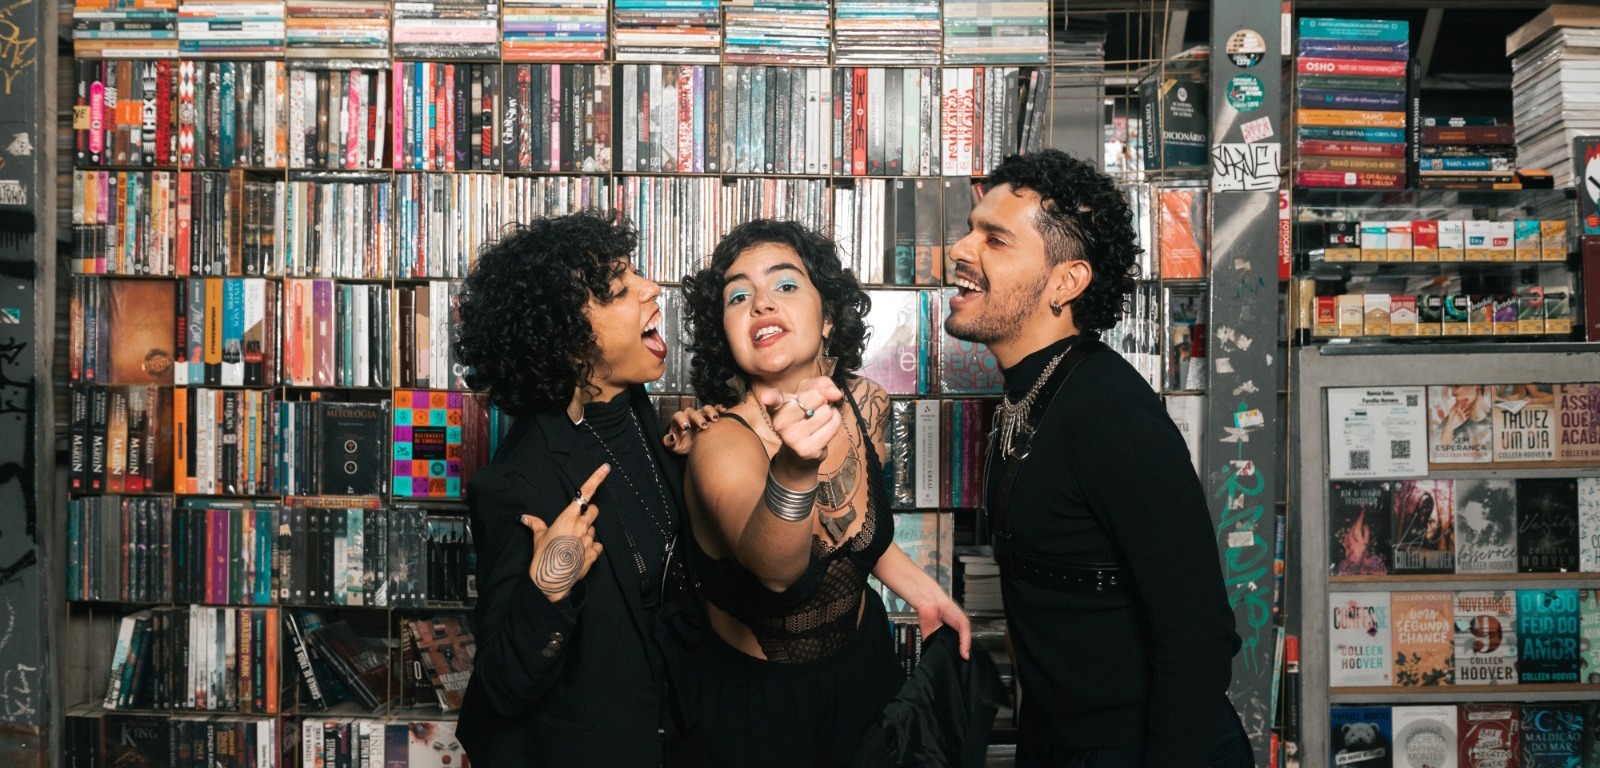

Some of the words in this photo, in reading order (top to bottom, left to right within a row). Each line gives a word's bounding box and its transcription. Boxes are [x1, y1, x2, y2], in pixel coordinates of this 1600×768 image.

[1306, 62, 1335, 72] OSHO
[143, 99, 157, 130] HEX
[1164, 131, 1205, 142] DICIONÁRIO
[327, 409, 377, 418] MITOLOGIA
[1502, 410, 1548, 429] TALVEZ
[1561, 412, 1589, 428] QUE
[1502, 431, 1522, 449] UM
[1528, 431, 1549, 449] DIA
[928, 460, 932, 468] DO
[1520, 513, 1578, 536] Verity
[1522, 556, 1575, 566] HOOVER
[1522, 594, 1531, 612] O
[1411, 608, 1437, 620] UMA
[240, 611, 250, 654] JURASSIC
[1396, 621, 1450, 632] SEGUNDA
[1522, 617, 1552, 634] FEIO
[1558, 617, 1577, 634] DO
[1400, 632, 1448, 644] CHANCE
[1470, 615, 1503, 653] 9
[1342, 646, 1383, 656] COLLEEN
[1523, 638, 1577, 659] AMOR
[240, 655, 250, 677] PARK
[1342, 659, 1383, 669] HOOVER
[1461, 667, 1512, 680] HOOVER
[306, 677, 320, 700] CAVALO
[120, 722, 158, 747] KING
[326, 738, 335, 760] STEPHEN
[1550, 743, 1573, 751] MAR
